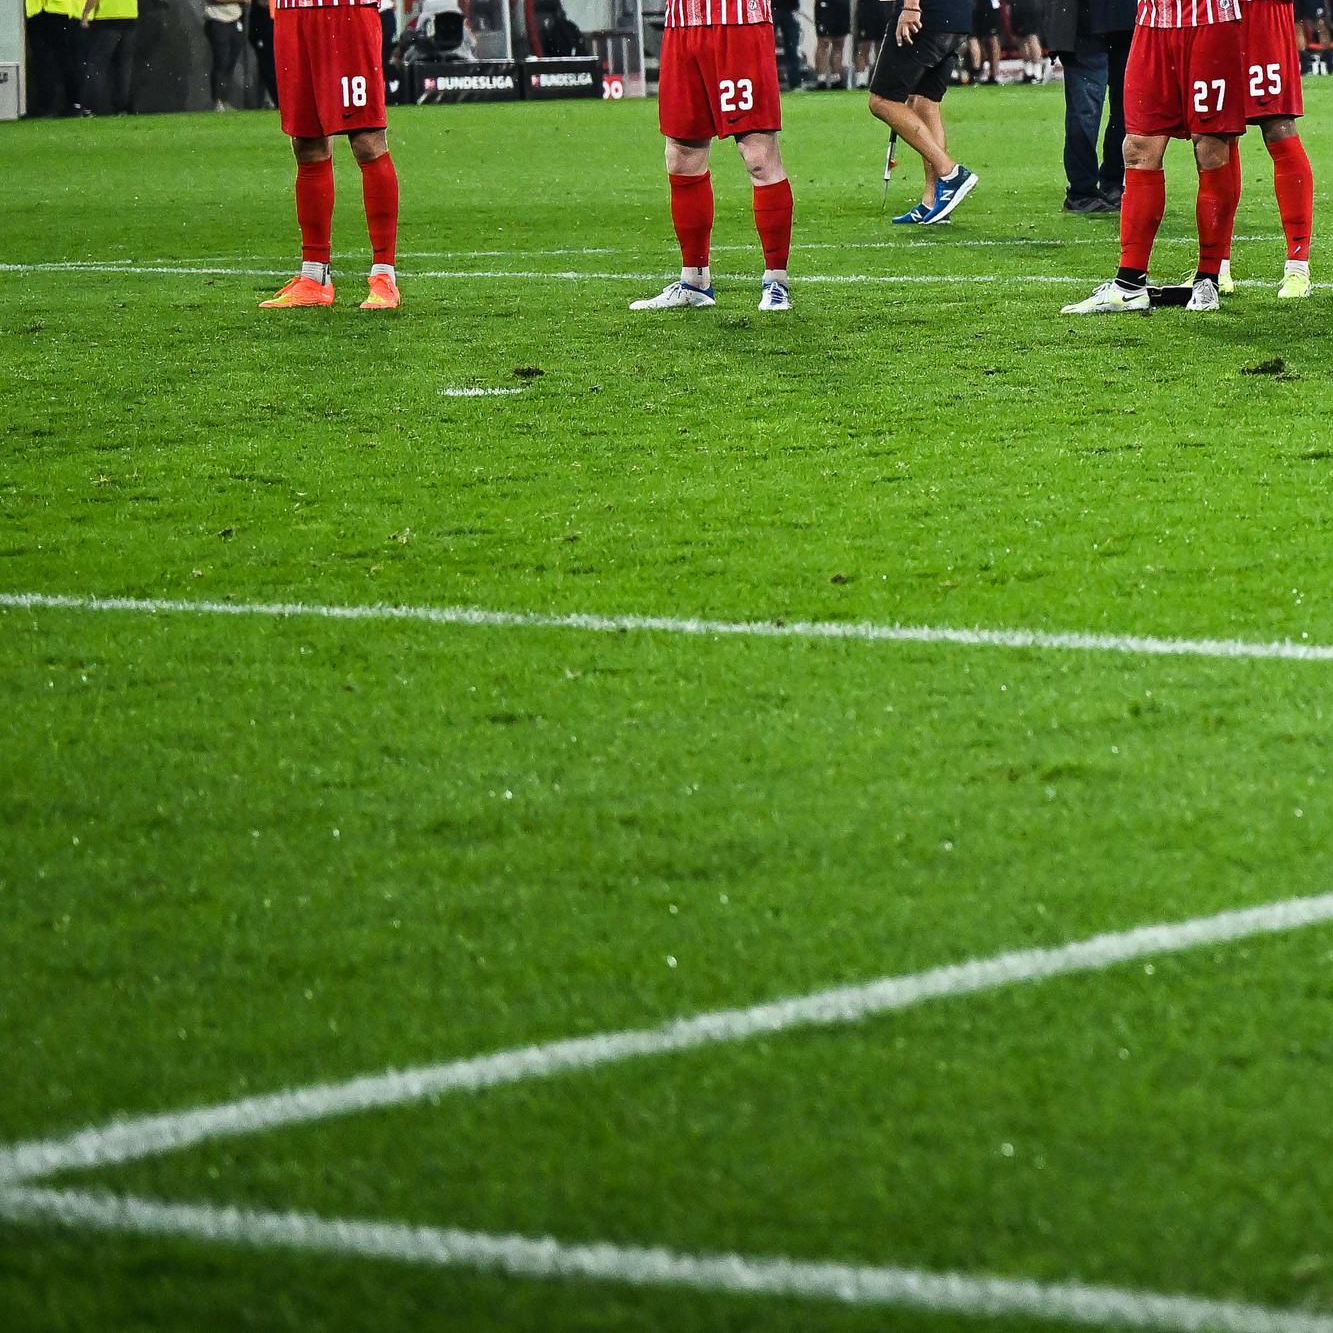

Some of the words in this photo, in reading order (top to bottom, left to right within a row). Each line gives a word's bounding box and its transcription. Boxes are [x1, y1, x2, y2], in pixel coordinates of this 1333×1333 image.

[341, 76, 367, 107] 18
[436, 75, 514, 91] BUNDESLIGA
[539, 72, 593, 87] BUNDESLIGA
[719, 78, 753, 111] 23
[1193, 78, 1226, 112] 27
[1248, 63, 1281, 97] 25
